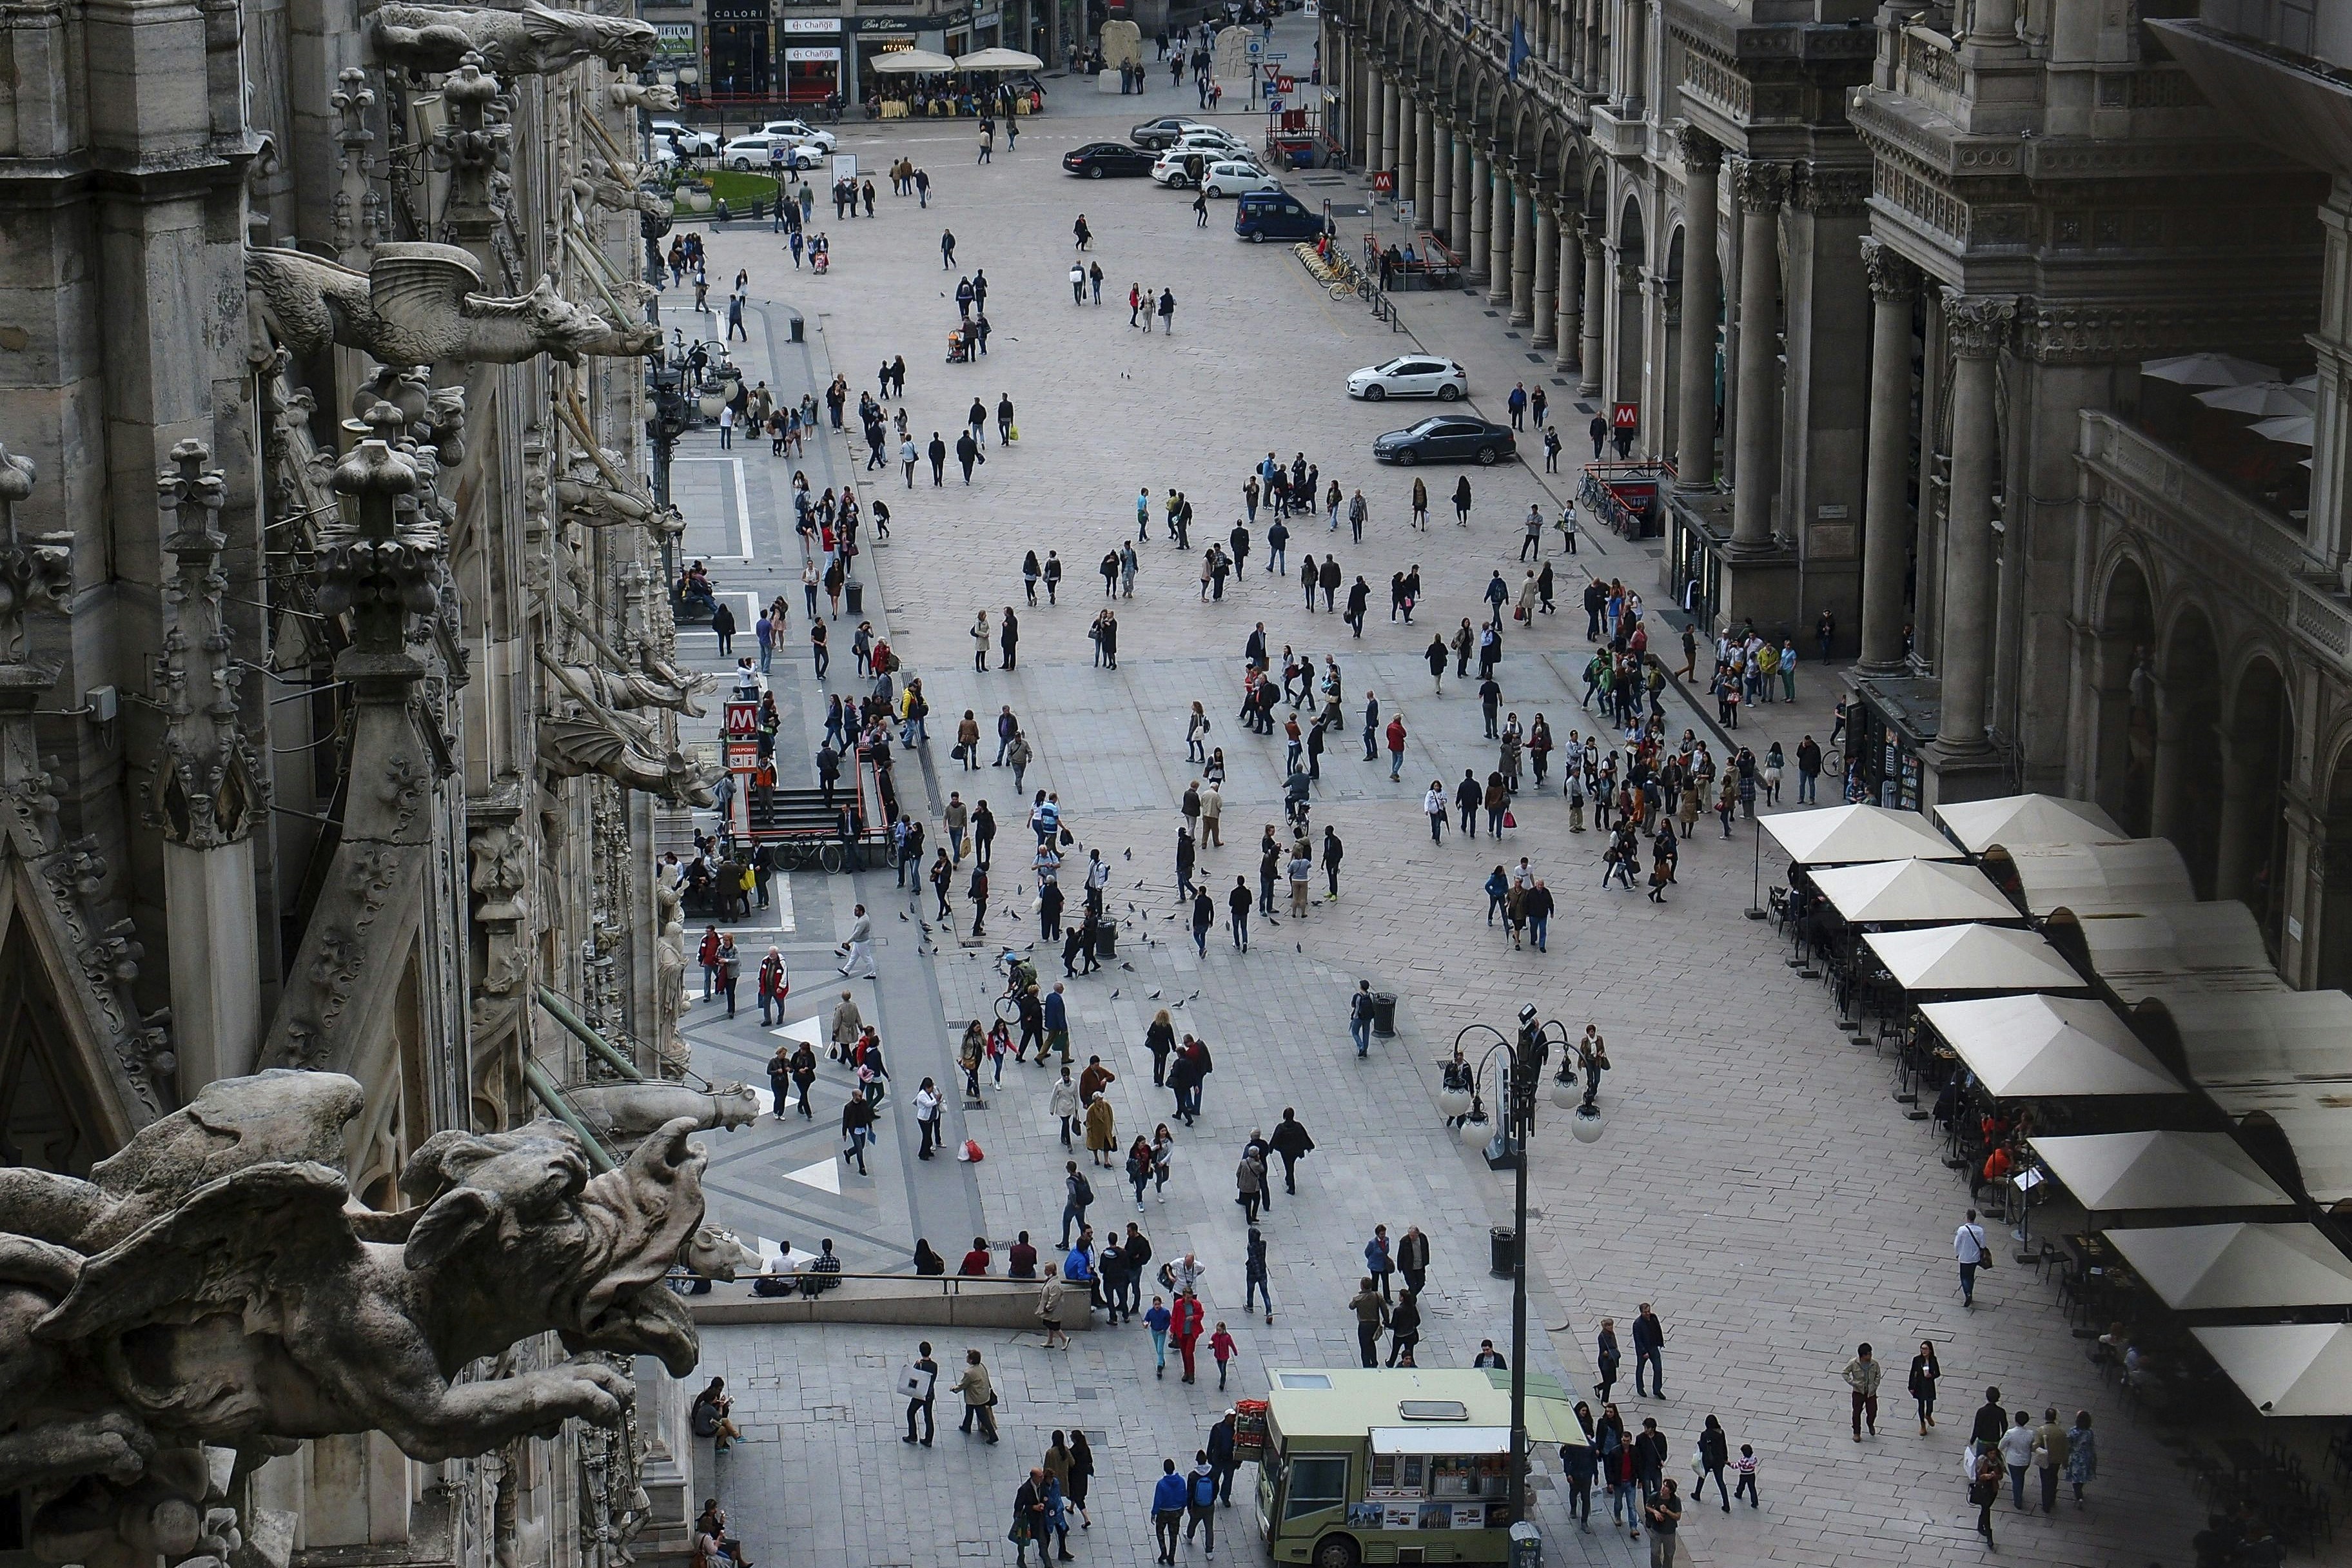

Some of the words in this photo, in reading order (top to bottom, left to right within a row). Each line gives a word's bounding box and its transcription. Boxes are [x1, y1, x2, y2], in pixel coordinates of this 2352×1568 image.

[804, 21, 833, 30] Change
[805, 50, 834, 59] Change
[1279, 79, 1292, 89] M
[1375, 175, 1390, 187] M
[1616, 408, 1635, 422] M
[730, 709, 755, 728] M
